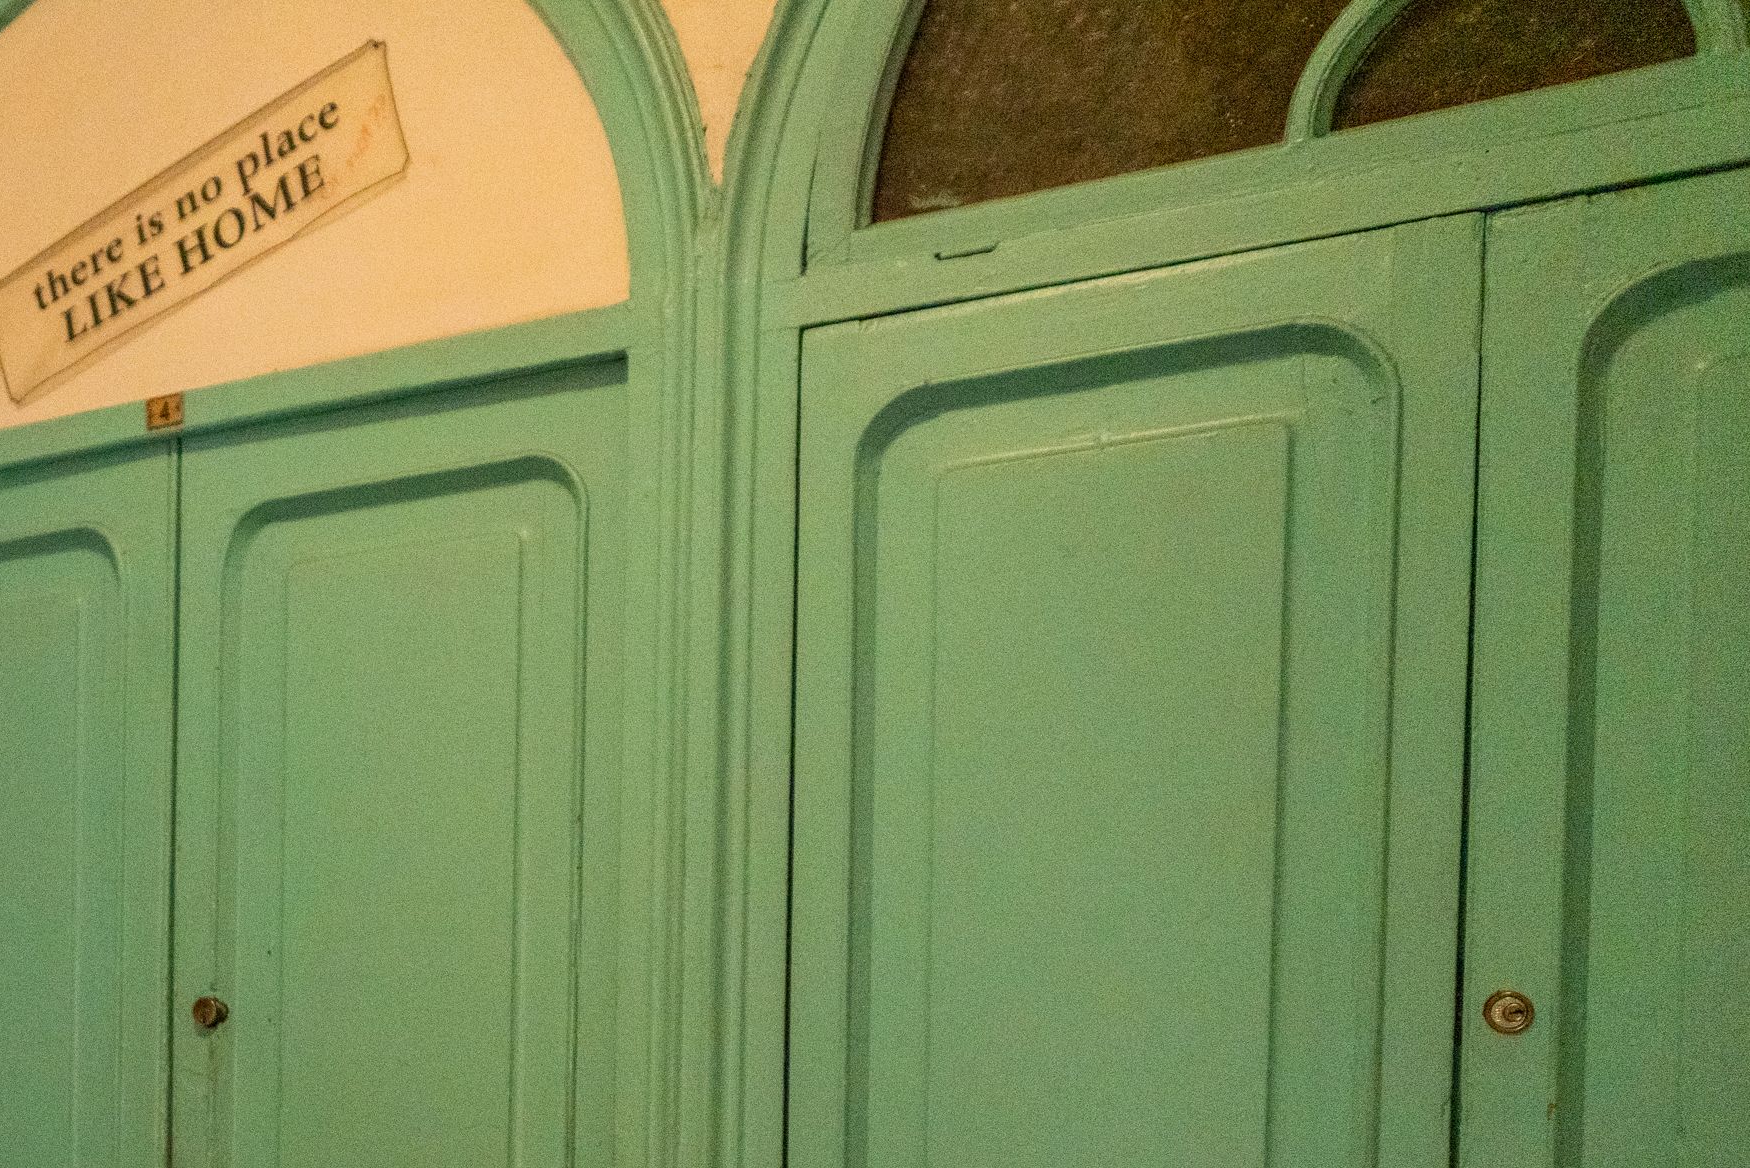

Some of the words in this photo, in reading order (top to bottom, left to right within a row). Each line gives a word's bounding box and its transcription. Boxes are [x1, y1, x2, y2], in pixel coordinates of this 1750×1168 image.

[33, 237, 123, 310] there
[135, 212, 165, 246] is
[175, 174, 223, 222] no
[237, 100, 340, 195] place
[60, 255, 166, 343] LIKE
[174, 154, 326, 276] HOME
[159, 400, 170, 421] 4
